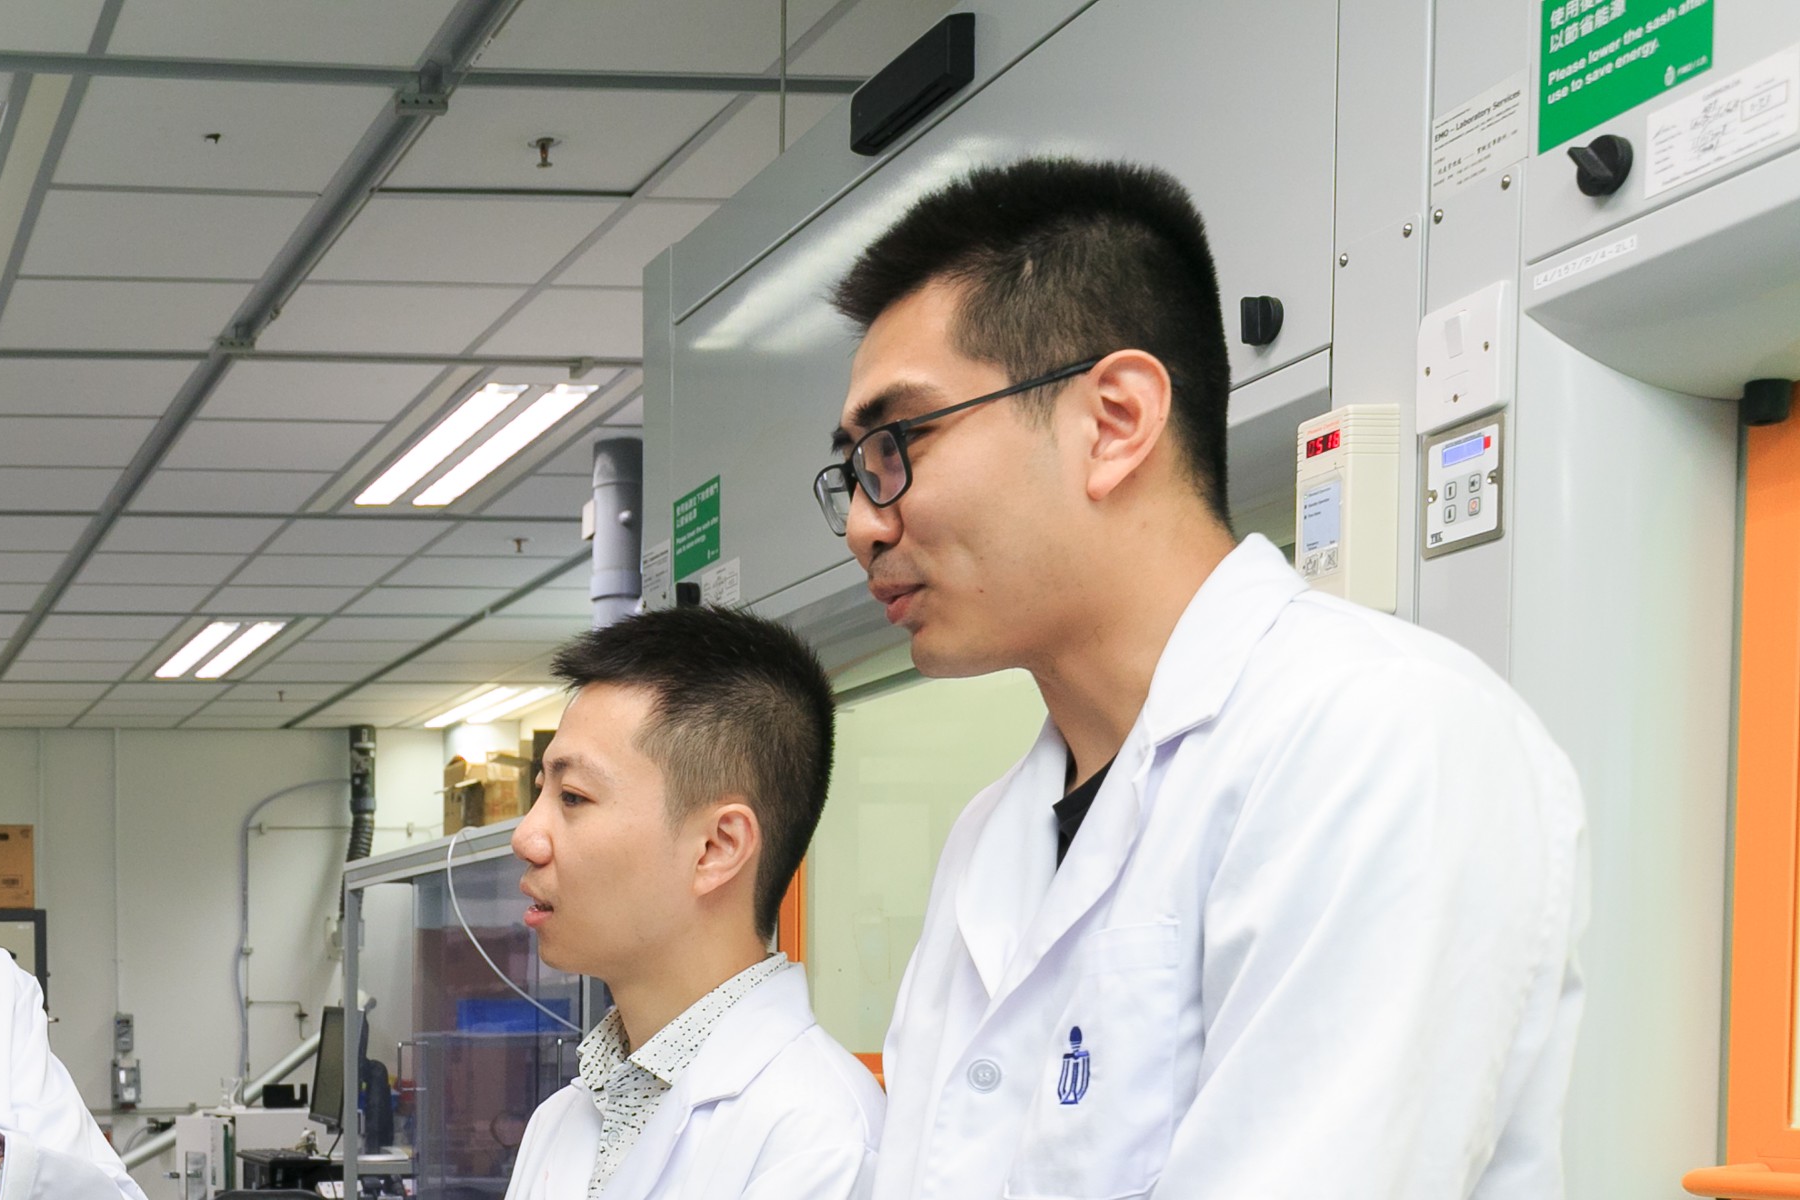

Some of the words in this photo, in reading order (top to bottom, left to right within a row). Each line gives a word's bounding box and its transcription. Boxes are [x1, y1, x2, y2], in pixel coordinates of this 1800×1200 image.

[1547, 57, 1587, 86] Please
[1587, 37, 1622, 64] lower
[1623, 26, 1644, 46] the
[1645, 6, 1677, 34] sash
[1547, 85, 1569, 105] use
[1570, 77, 1584, 92] to
[1584, 61, 1614, 85] save
